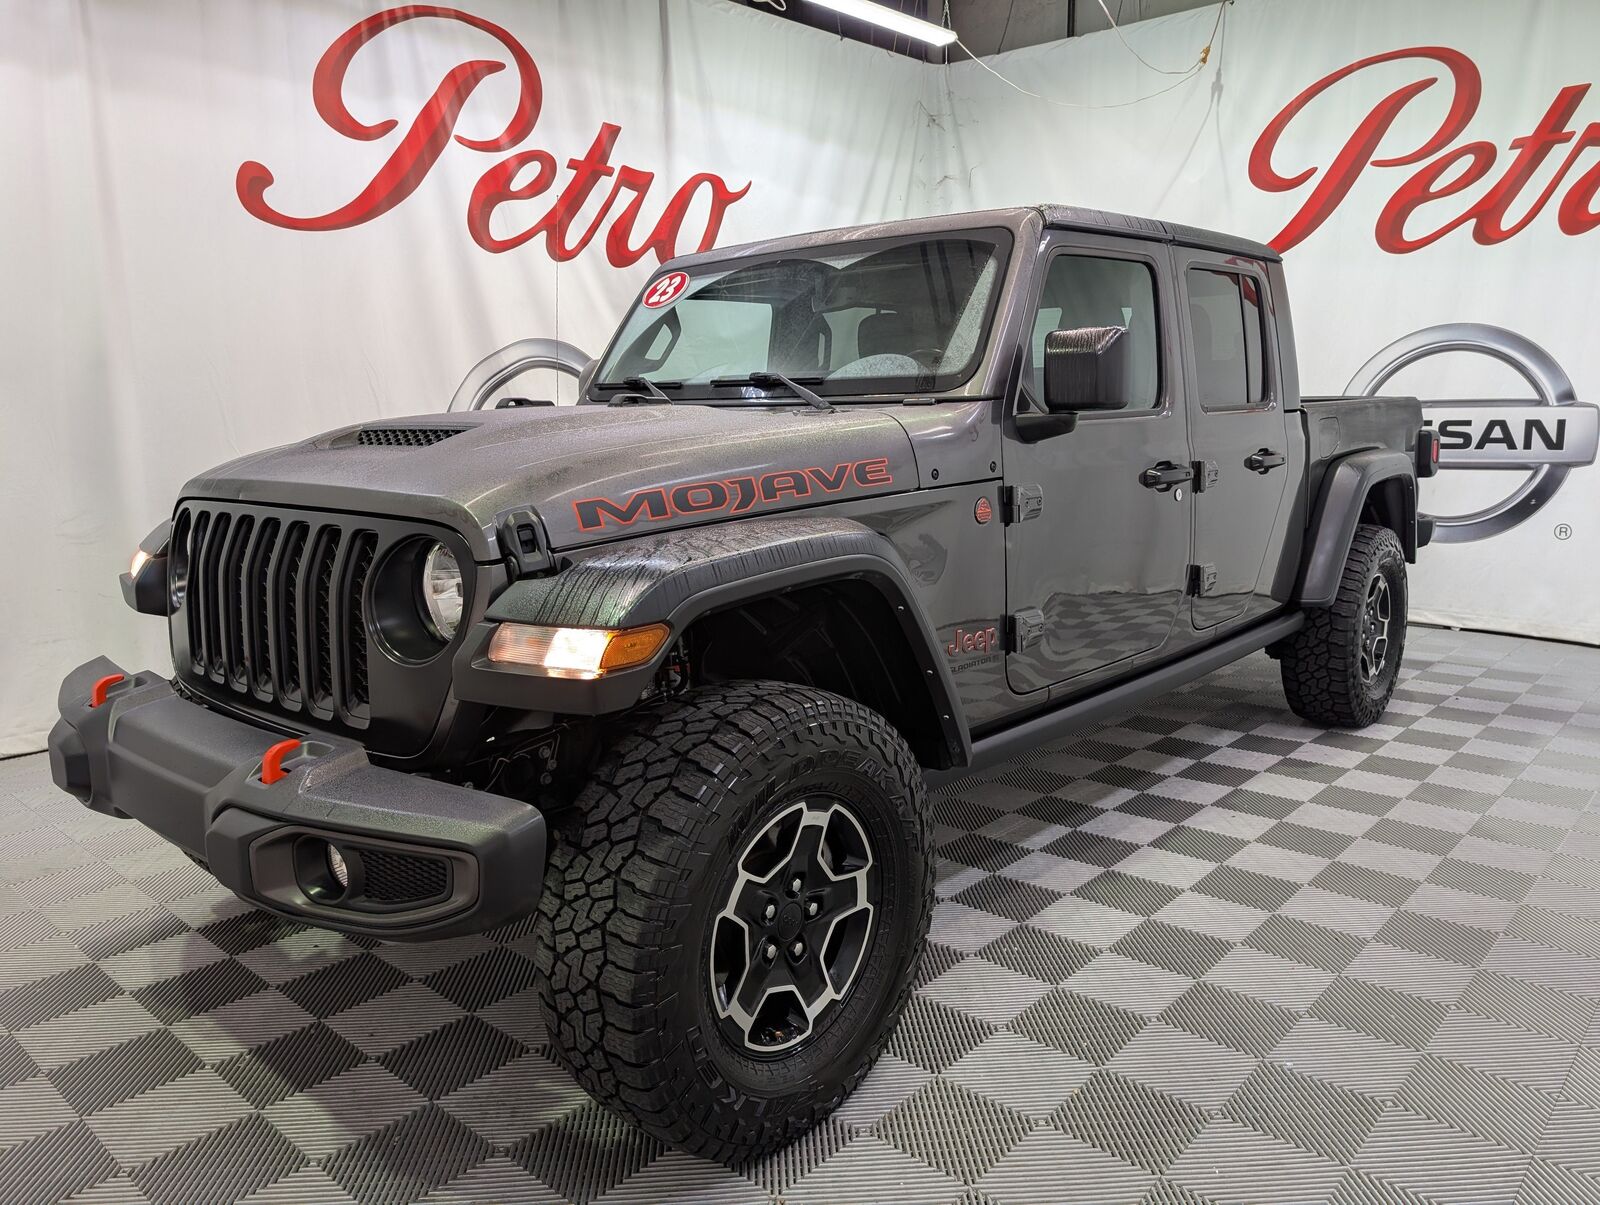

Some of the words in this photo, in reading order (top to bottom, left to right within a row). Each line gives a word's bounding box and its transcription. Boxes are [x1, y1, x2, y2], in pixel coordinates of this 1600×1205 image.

[236, 4, 752, 268] Petro
[648, 275, 682, 304] 23
[1423, 419, 1566, 450] SAN
[573, 458, 893, 532] MOJAVE
[947, 627, 998, 657] Jeep
